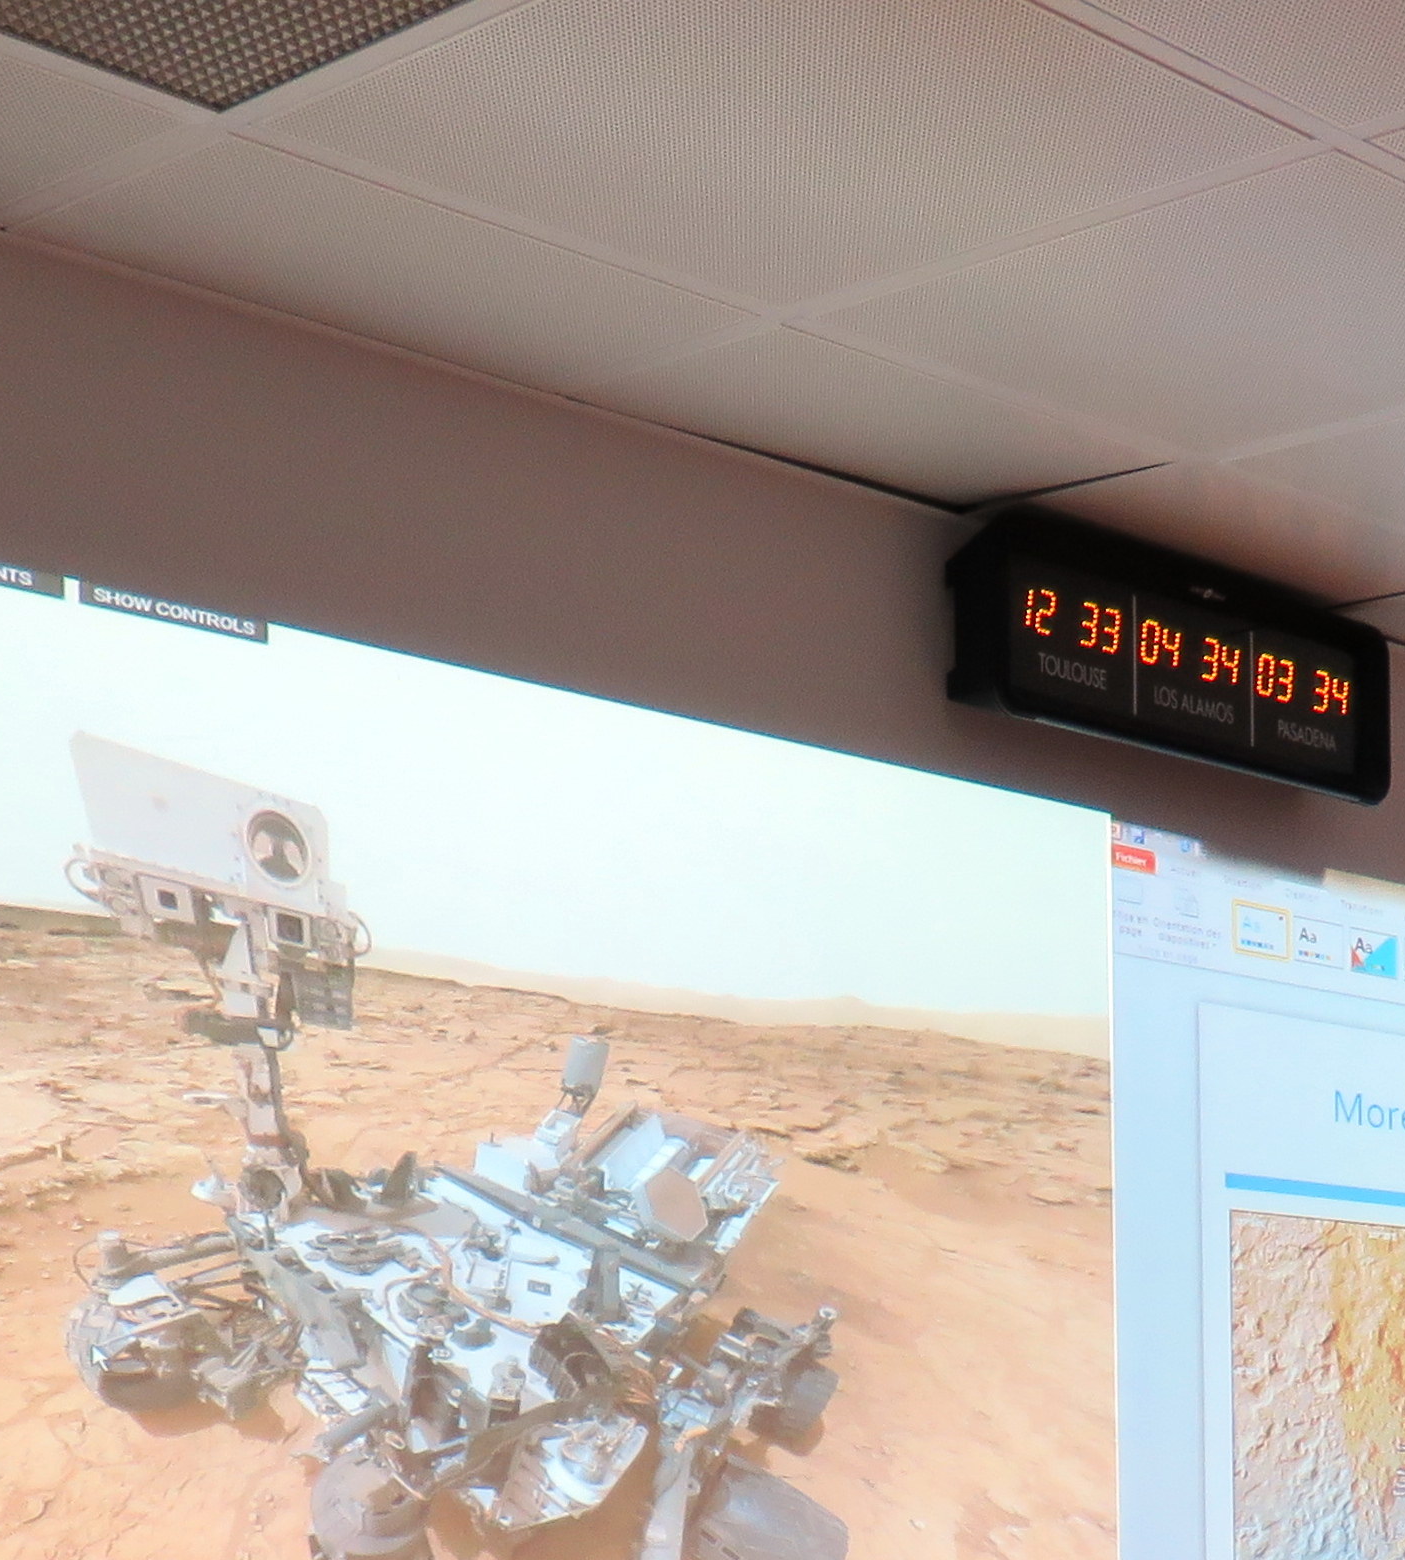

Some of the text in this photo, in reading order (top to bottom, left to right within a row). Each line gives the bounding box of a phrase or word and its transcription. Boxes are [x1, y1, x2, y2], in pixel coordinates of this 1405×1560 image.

[93, 586, 256, 636] SHOW CONTROLS
[1025, 589, 1122, 654] 12 33
[1038, 651, 1108, 691] TOULOUSE
[1140, 619, 1240, 684] 04 34
[1256, 653, 1350, 715] 03 34
[1154, 686, 1235, 724] LOS ALAMOS
[1277, 720, 1337, 753] PASADENA
[1115, 850, 1148, 867] Fichier
[1299, 927, 1317, 944] Aa
[1356, 937, 1373, 954] Aa
